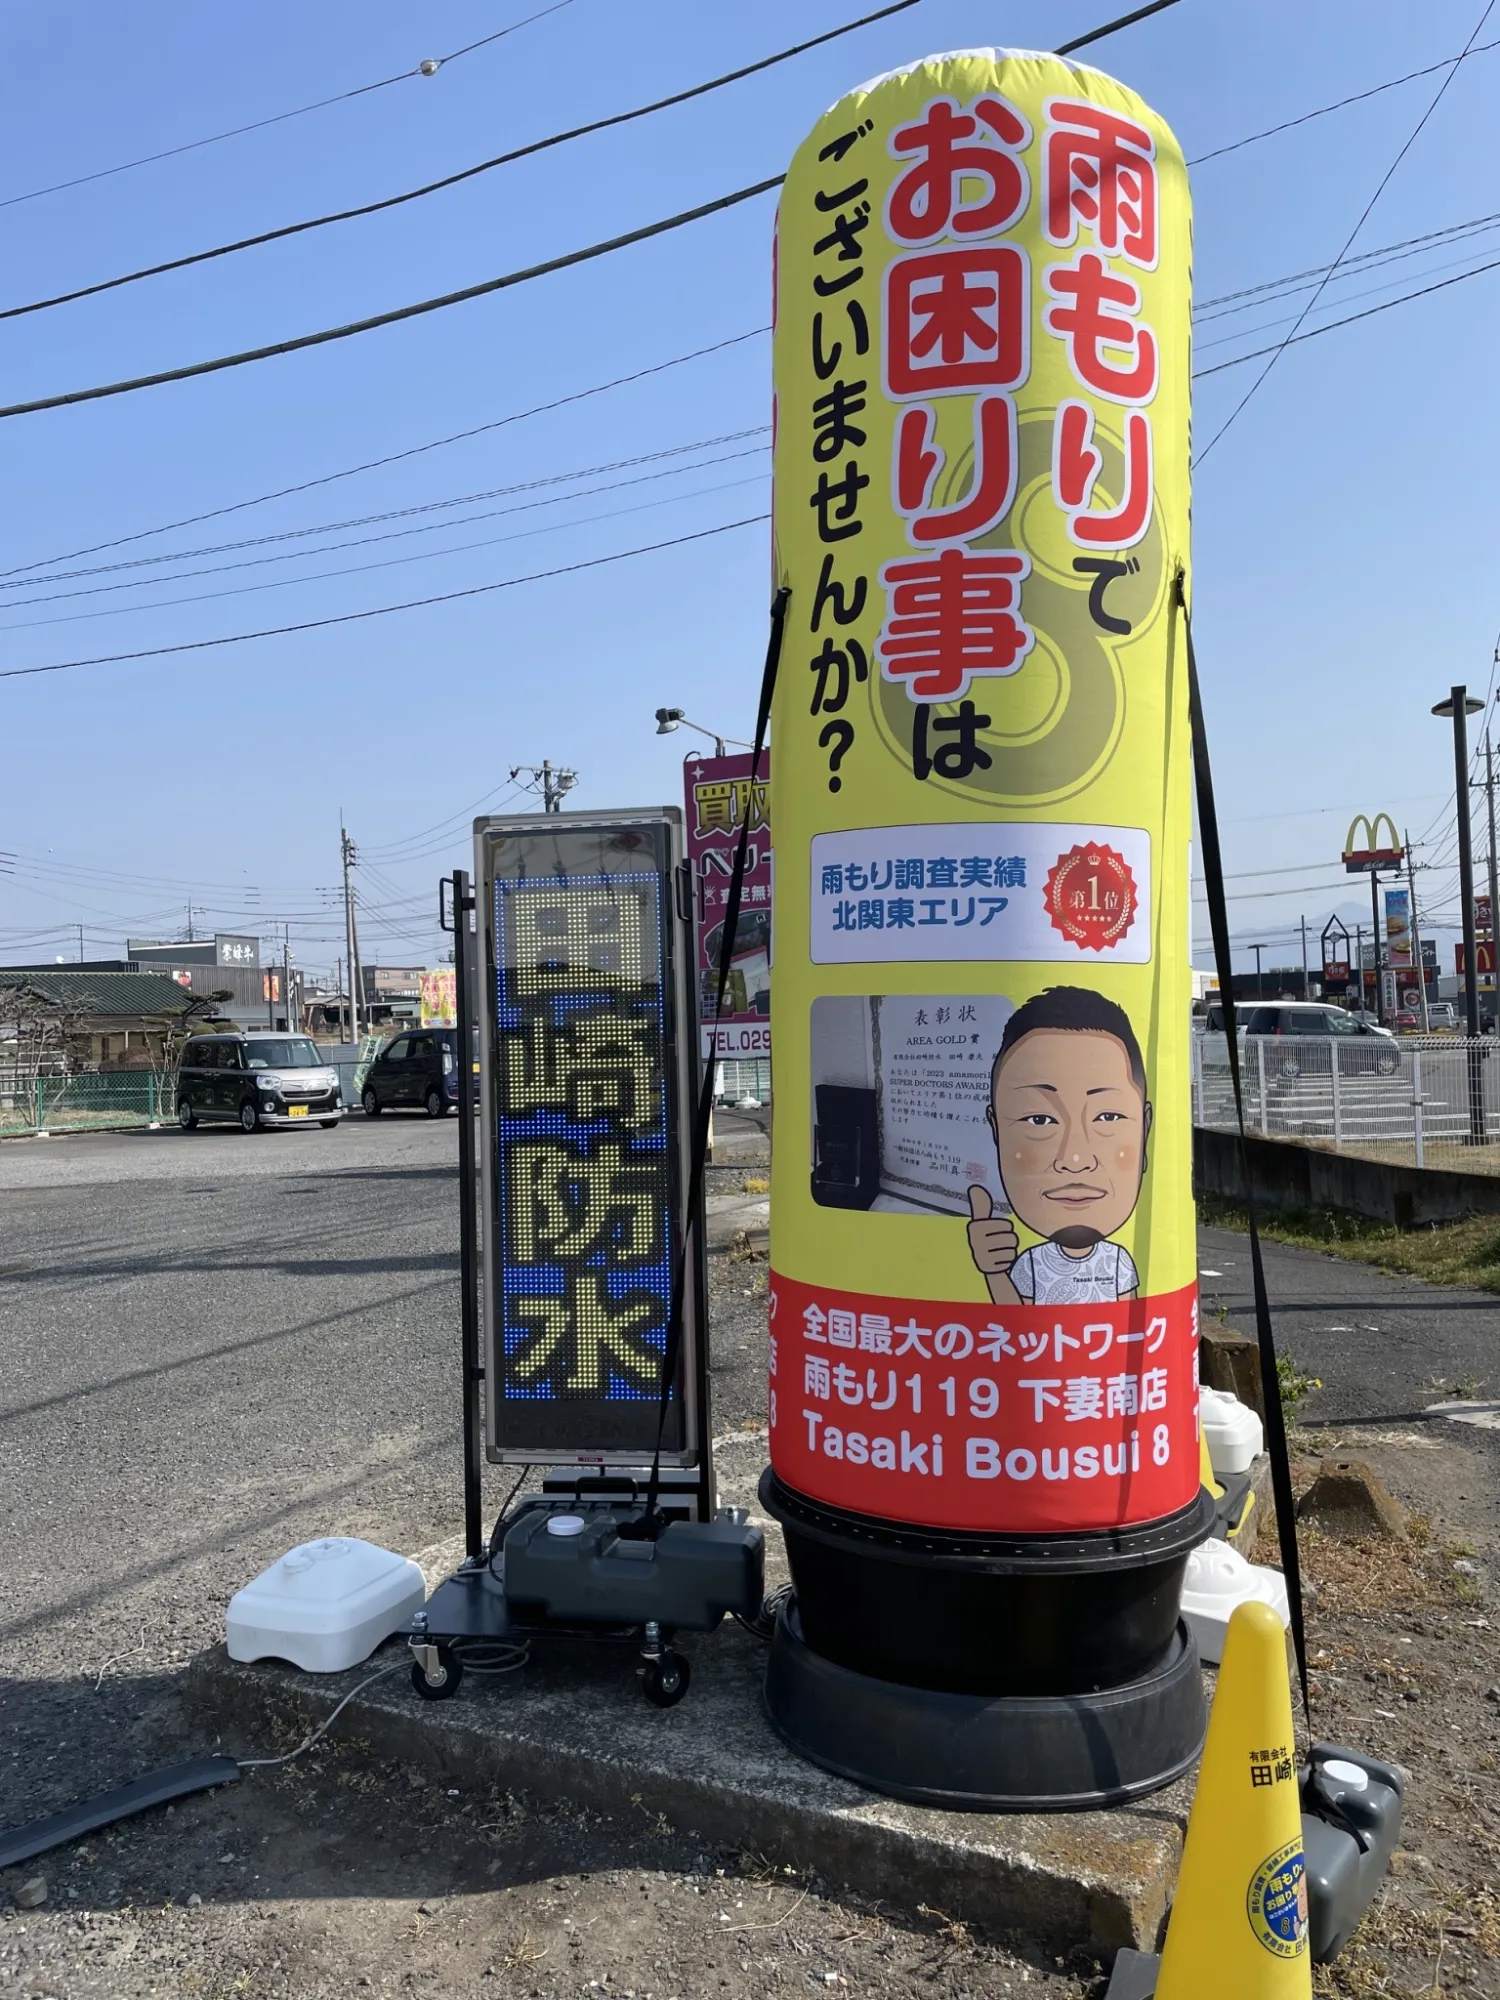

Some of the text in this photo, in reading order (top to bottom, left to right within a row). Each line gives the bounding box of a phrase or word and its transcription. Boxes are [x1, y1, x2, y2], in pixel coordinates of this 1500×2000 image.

[1042, 98, 1158, 634] 雨もりで
[808, 118, 875, 794] ございませんか？
[877, 96, 1032, 779] お困り事は
[696, 780, 770, 835] 買取
[720, 885, 771, 904] 査定無
[820, 856, 1027, 896] 雨もり調査実績
[1069, 875, 1120, 910] 第1位
[832, 896, 1009, 931] 北関東エリア
[915, 1005, 977, 1026] 表彰状
[906, 1037, 933, 1045] AREA
[936, 1035, 966, 1045] GOLD
[889, 1078, 989, 1091] SUPER DOCTORS AWARD
[508, 892, 657, 1389] 田崎防水
[803, 1302, 1168, 1362] 全国最大のネットワーク
[804, 1353, 999, 1419] 雨もり119
[1018, 1367, 1168, 1422] 下妻南店
[802, 1410, 1170, 1480] Tasaki Bousui 8
[1249, 1746, 1287, 1763] 有限会社
[1251, 1753, 1296, 1787] 田崎
